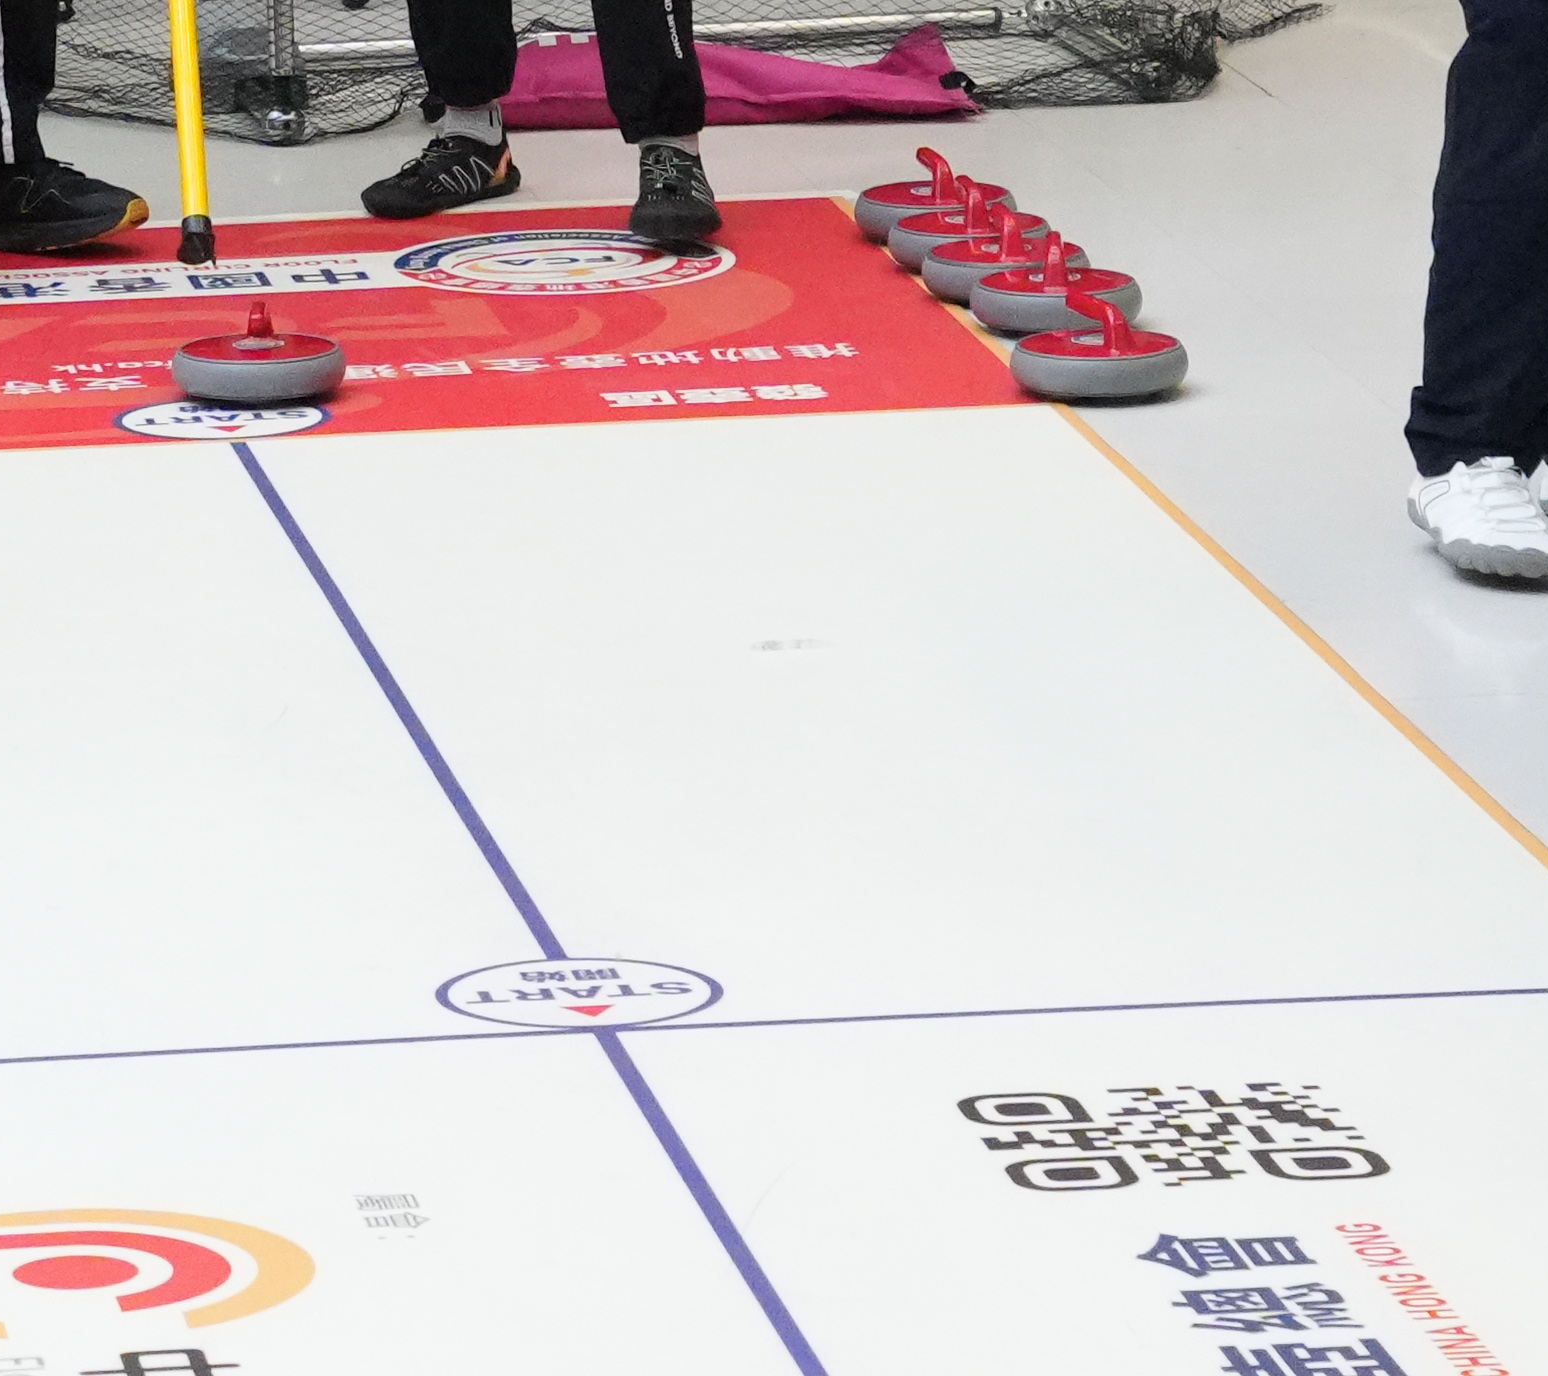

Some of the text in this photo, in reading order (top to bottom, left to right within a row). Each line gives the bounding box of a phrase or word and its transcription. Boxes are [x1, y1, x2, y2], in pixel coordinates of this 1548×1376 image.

[666, 13, 684, 60] BEYOND
[120, 263, 254, 274] CURLING
[262, 258, 359, 269] FLOOR
[496, 254, 617, 267] FCA
[599, 383, 829, 409] 發壺區
[135, 408, 309, 428] START
[519, 966, 622, 984] 開始
[465, 980, 693, 1005] START
[1334, 1222, 1414, 1268] KONG
[1378, 1271, 1461, 1322] HONG
